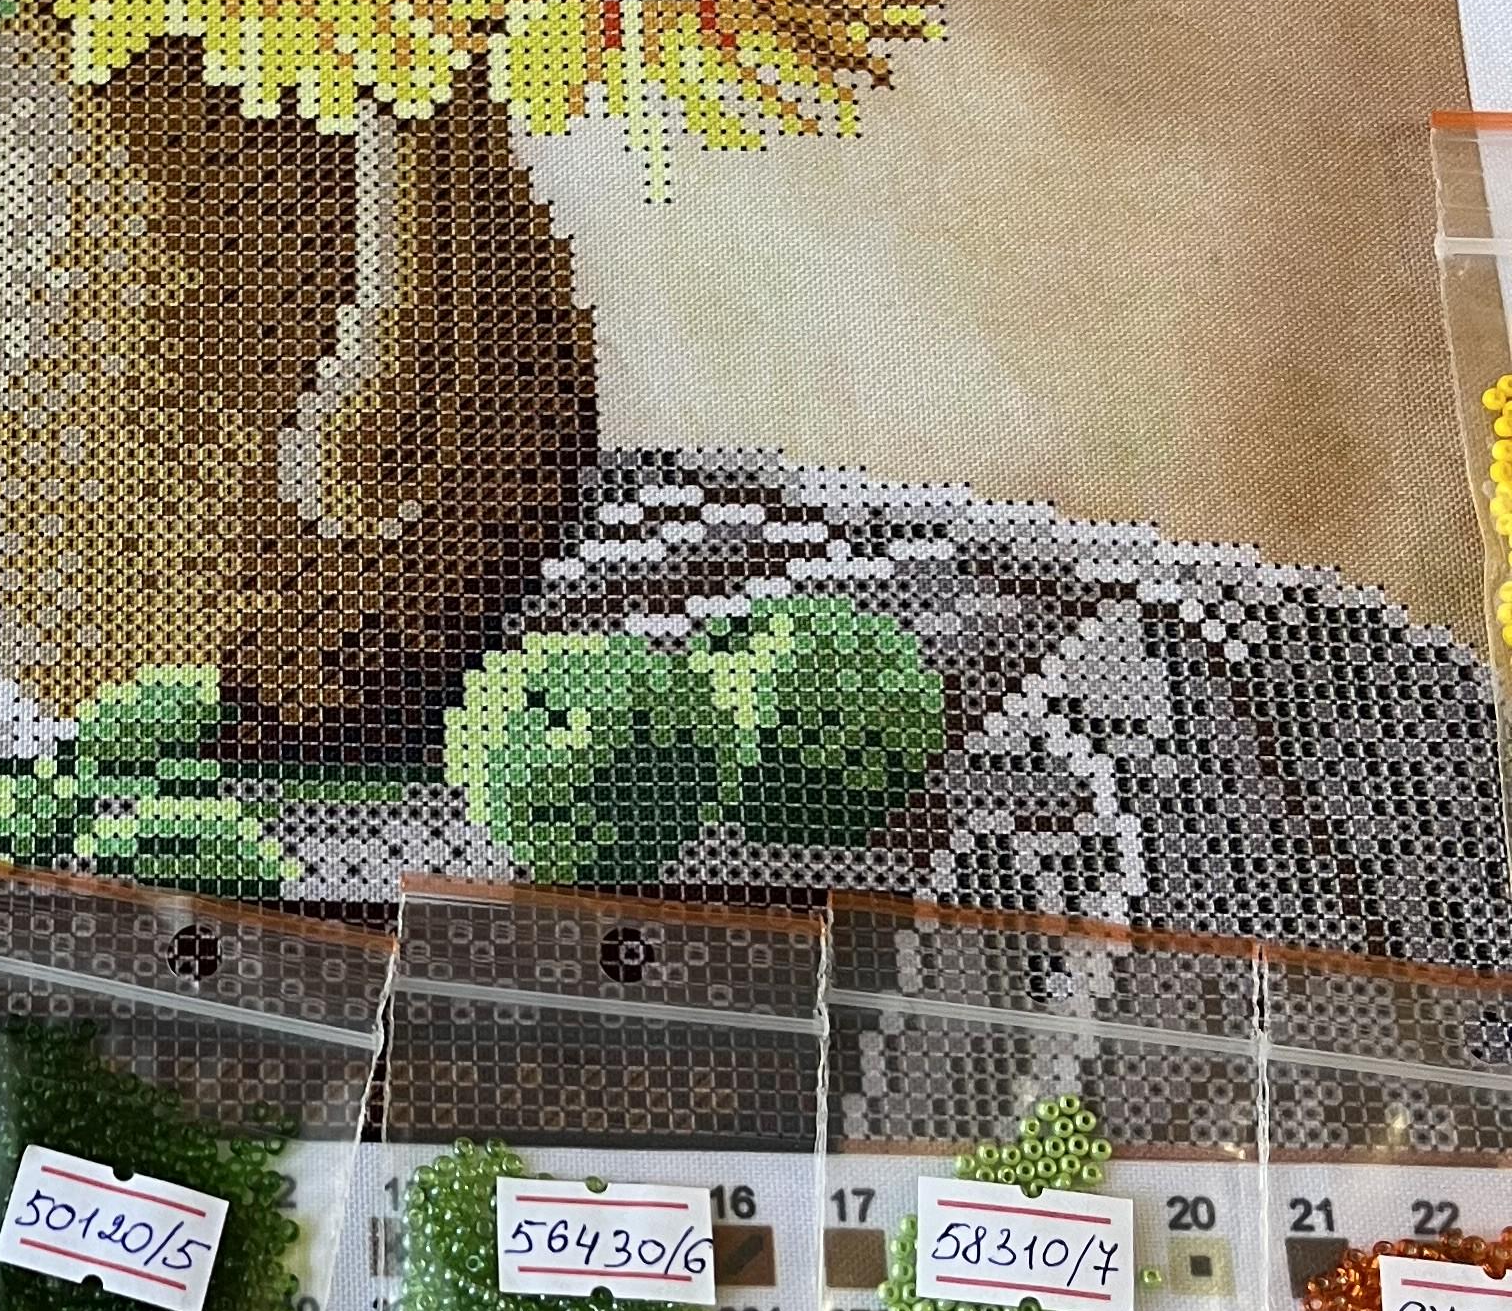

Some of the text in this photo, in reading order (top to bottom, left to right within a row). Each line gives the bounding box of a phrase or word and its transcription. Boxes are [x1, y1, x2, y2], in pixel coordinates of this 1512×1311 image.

[15, 1190, 211, 1270] 50120/5
[831, 1189, 876, 1222] 17
[1167, 1196, 1216, 1231] 20
[1289, 1198, 1335, 1232] 21
[504, 1220, 714, 1277] 56430/6
[932, 1222, 1120, 1288] 58310/7
